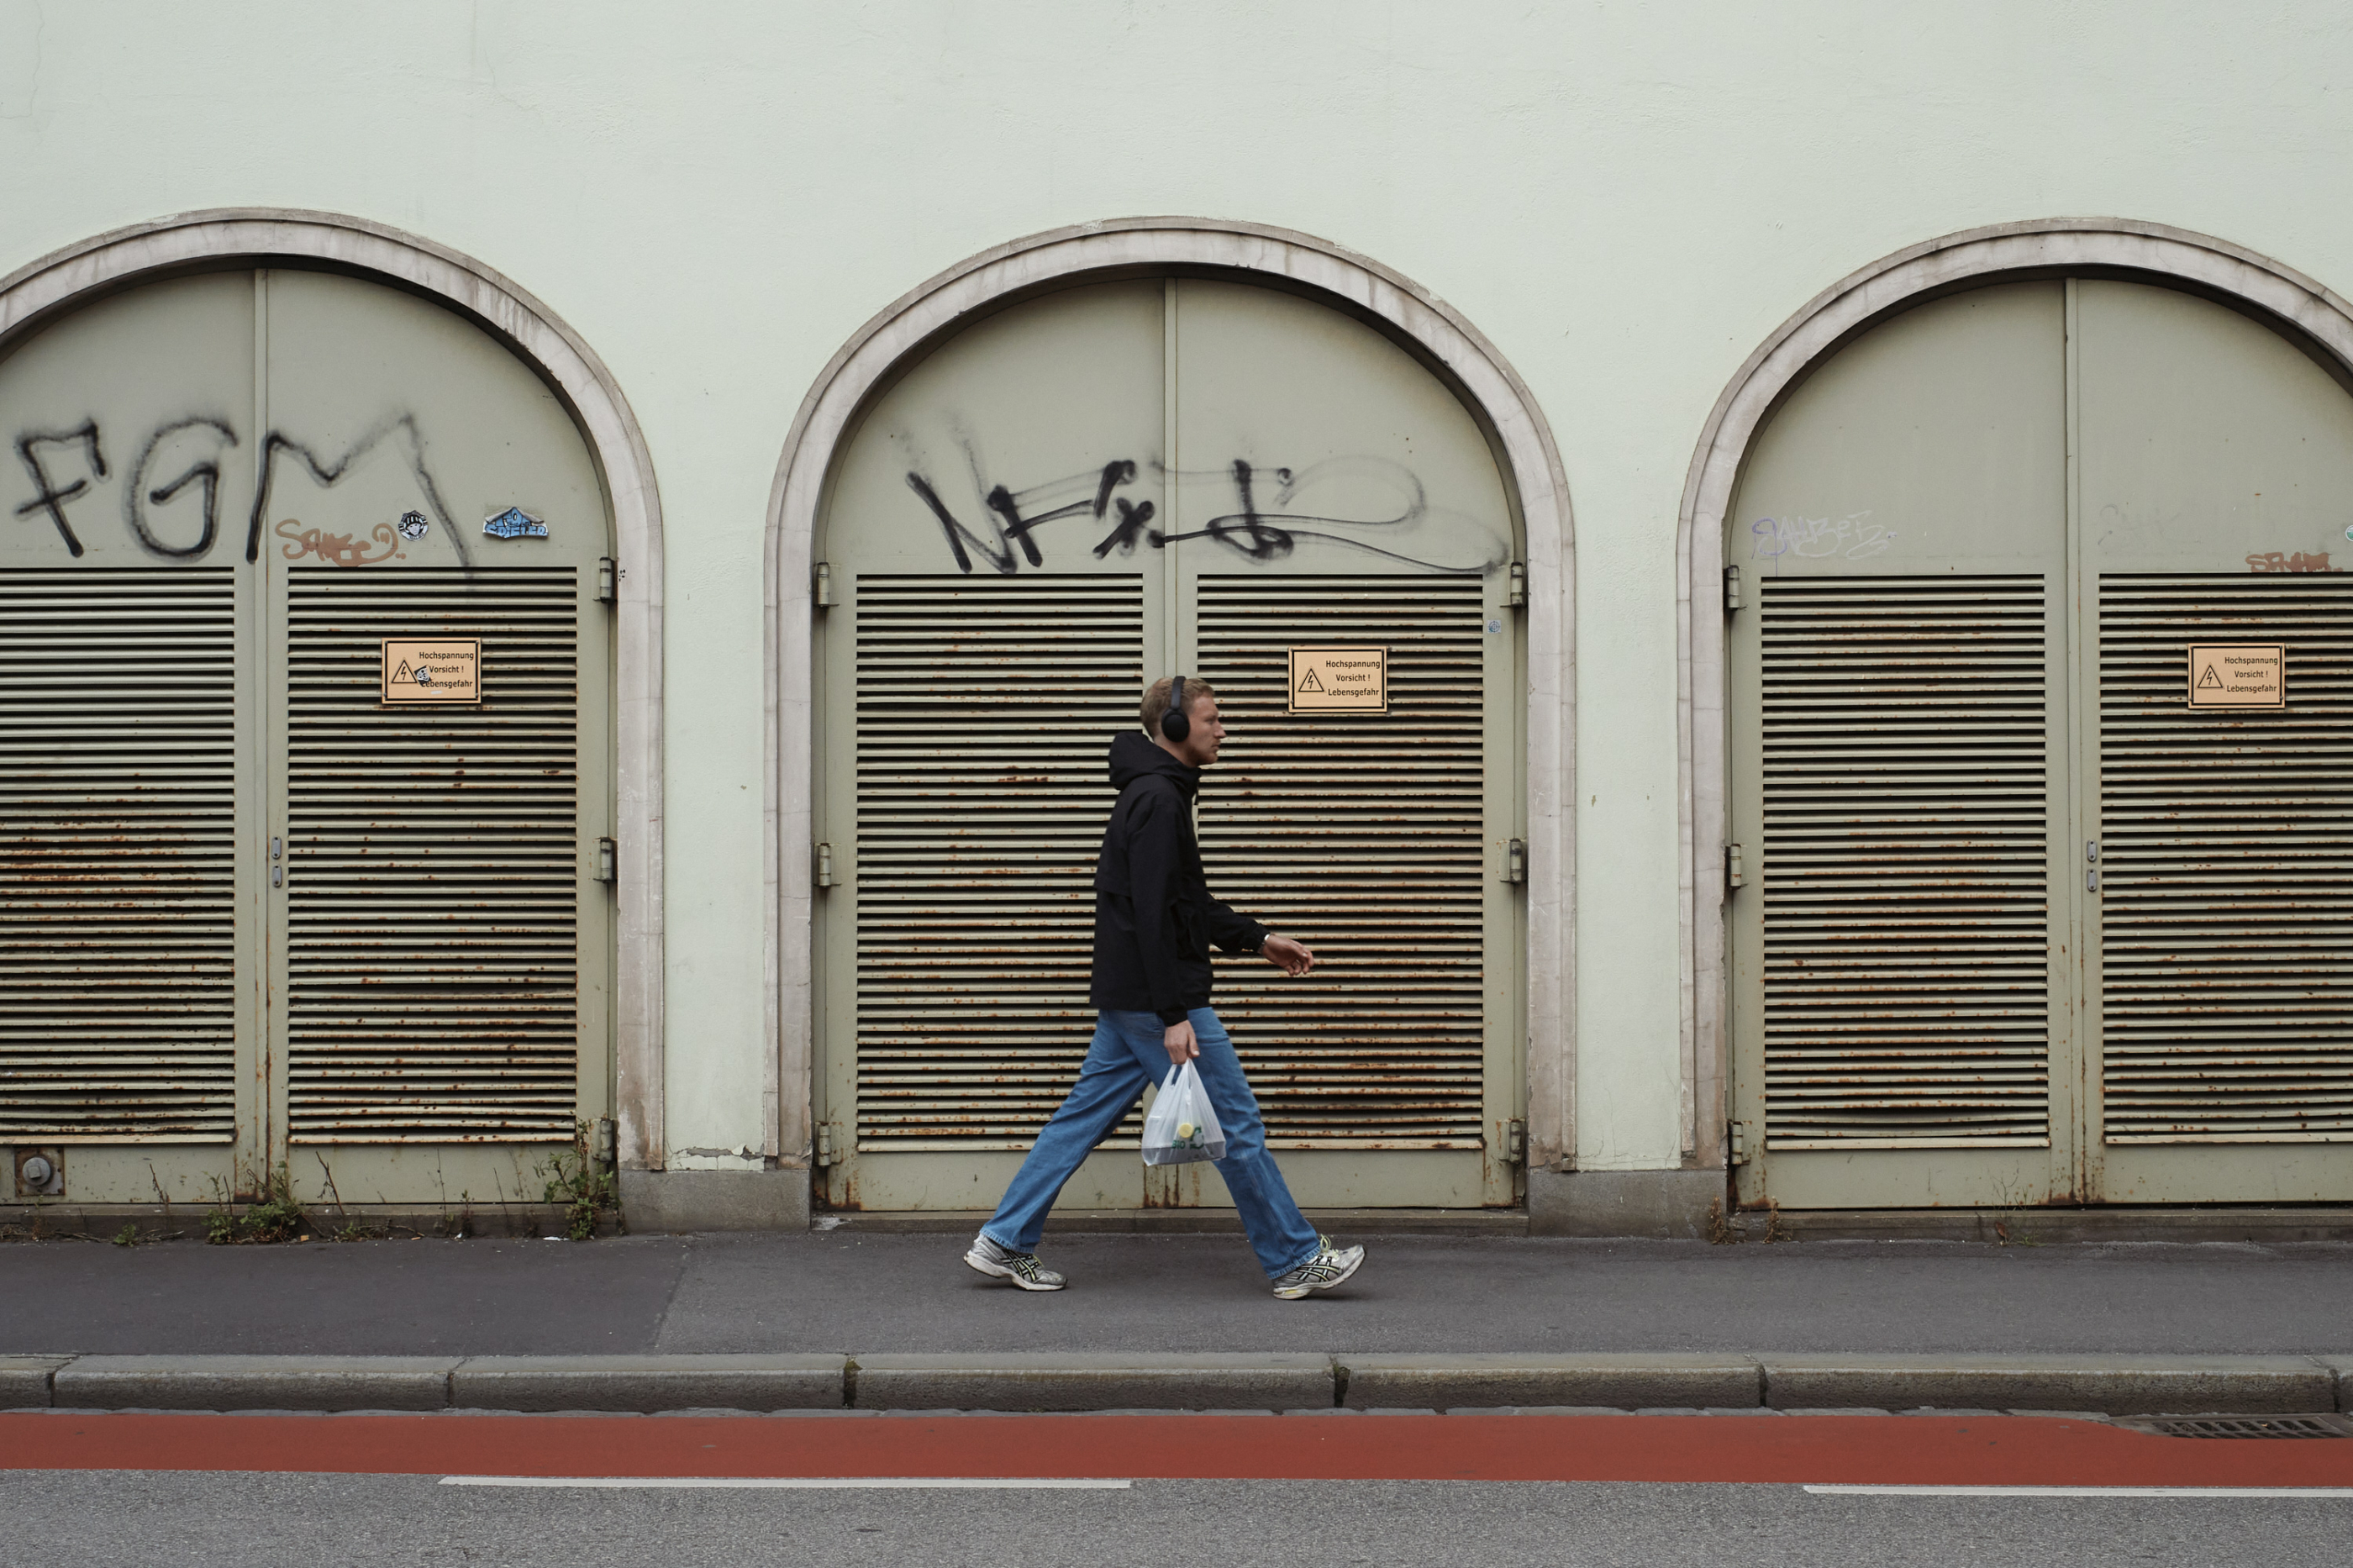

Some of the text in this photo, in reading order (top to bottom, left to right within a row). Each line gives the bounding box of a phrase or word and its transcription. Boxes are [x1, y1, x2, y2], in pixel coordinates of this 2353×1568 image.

[418, 651, 474, 660] Hochspannung
[1325, 660, 1381, 669] Hochspannung
[2224, 656, 2278, 666] Hochspannung
[429, 665, 460, 673] Vorsicht
[1328, 688, 1379, 697] Lebensgefahr
[2226, 685, 2277, 694] Lebensgefahr
